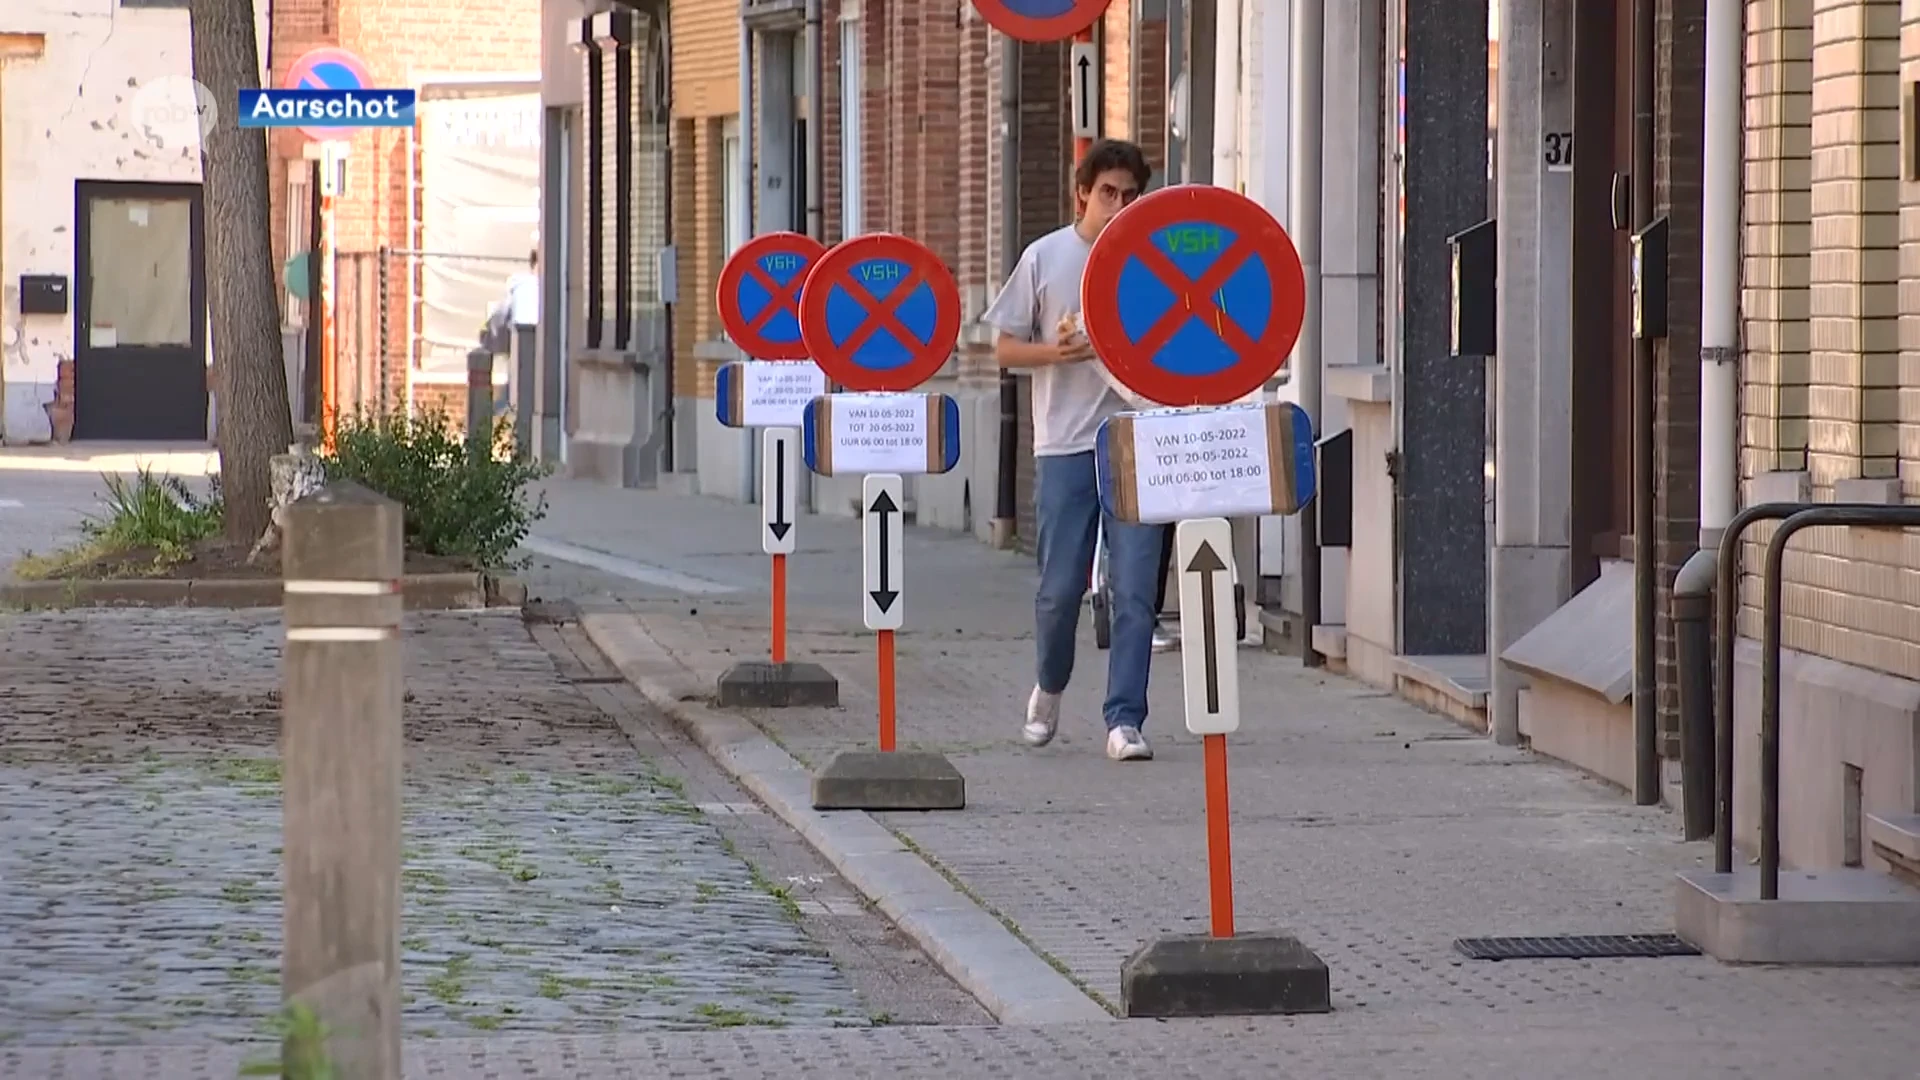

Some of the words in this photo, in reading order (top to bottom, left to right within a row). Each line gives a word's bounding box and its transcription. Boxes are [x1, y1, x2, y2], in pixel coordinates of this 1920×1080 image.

[1545, 133, 1572, 164] 37
[849, 409, 867, 418] VAN
[849, 423, 865, 432] TOT
[840, 437, 859, 446] UUR
[886, 437, 898, 446] tot
[1155, 434, 1180, 447] VAN
[1183, 428, 1246, 445] 10-05-2022
[1156, 454, 1179, 466] TOT
[1185, 447, 1248, 464] 20-05-2022
[1148, 475, 1174, 486] UUR
[1175, 471, 1208, 483] 06:00
[1211, 469, 1227, 480] tot
[1230, 465, 1261, 479] 18:00
